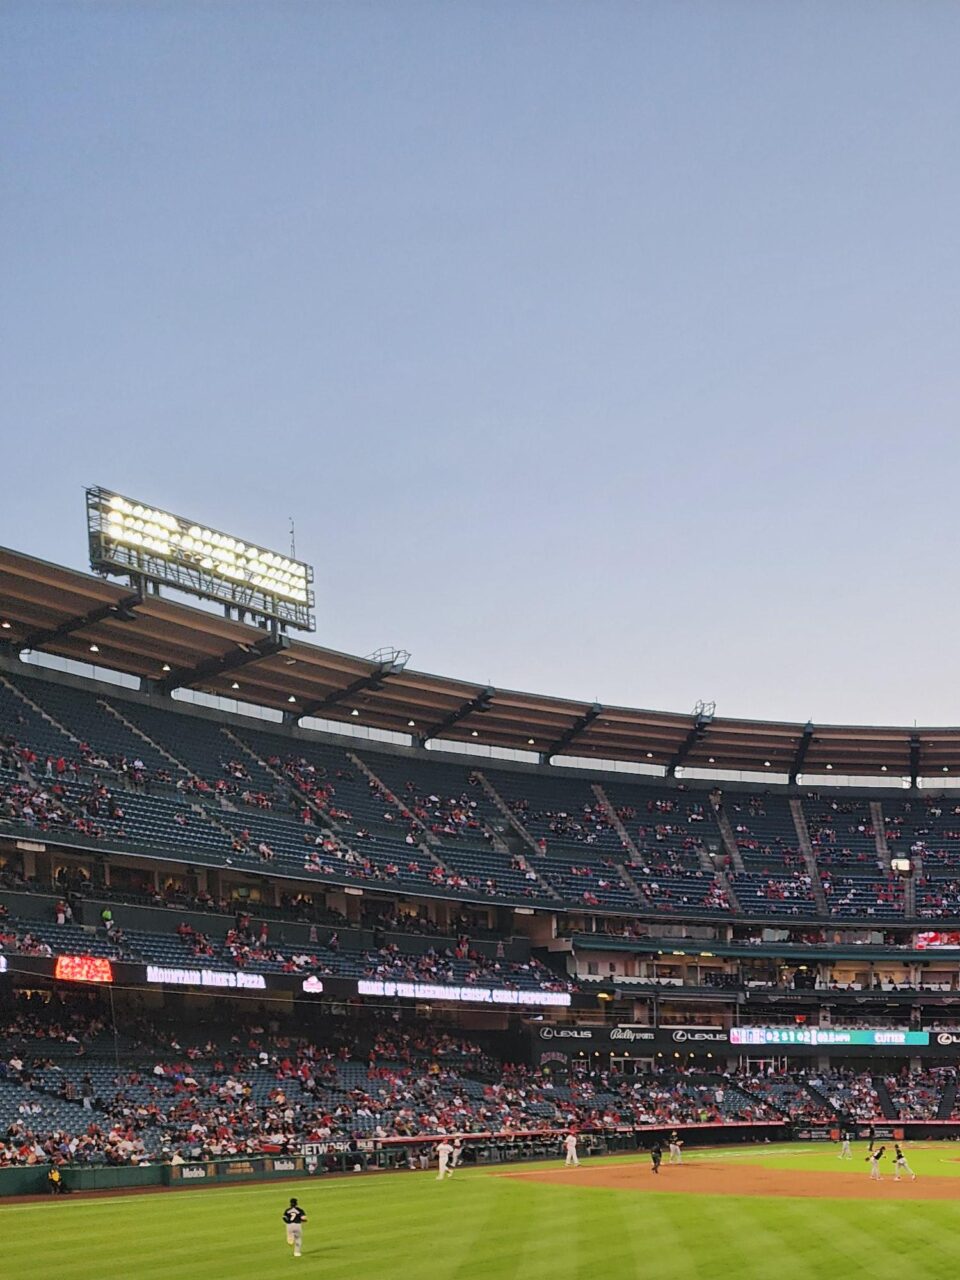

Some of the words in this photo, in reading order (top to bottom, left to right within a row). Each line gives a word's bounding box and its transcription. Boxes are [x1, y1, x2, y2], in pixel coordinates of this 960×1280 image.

[554, 1030, 592, 1038] LEXUS
[610, 1028, 635, 1041] Bally
[688, 1032, 727, 1041] LEXUS
[182, 1168, 206, 1178] Modelo
[290, 1213, 297, 1221] 7
